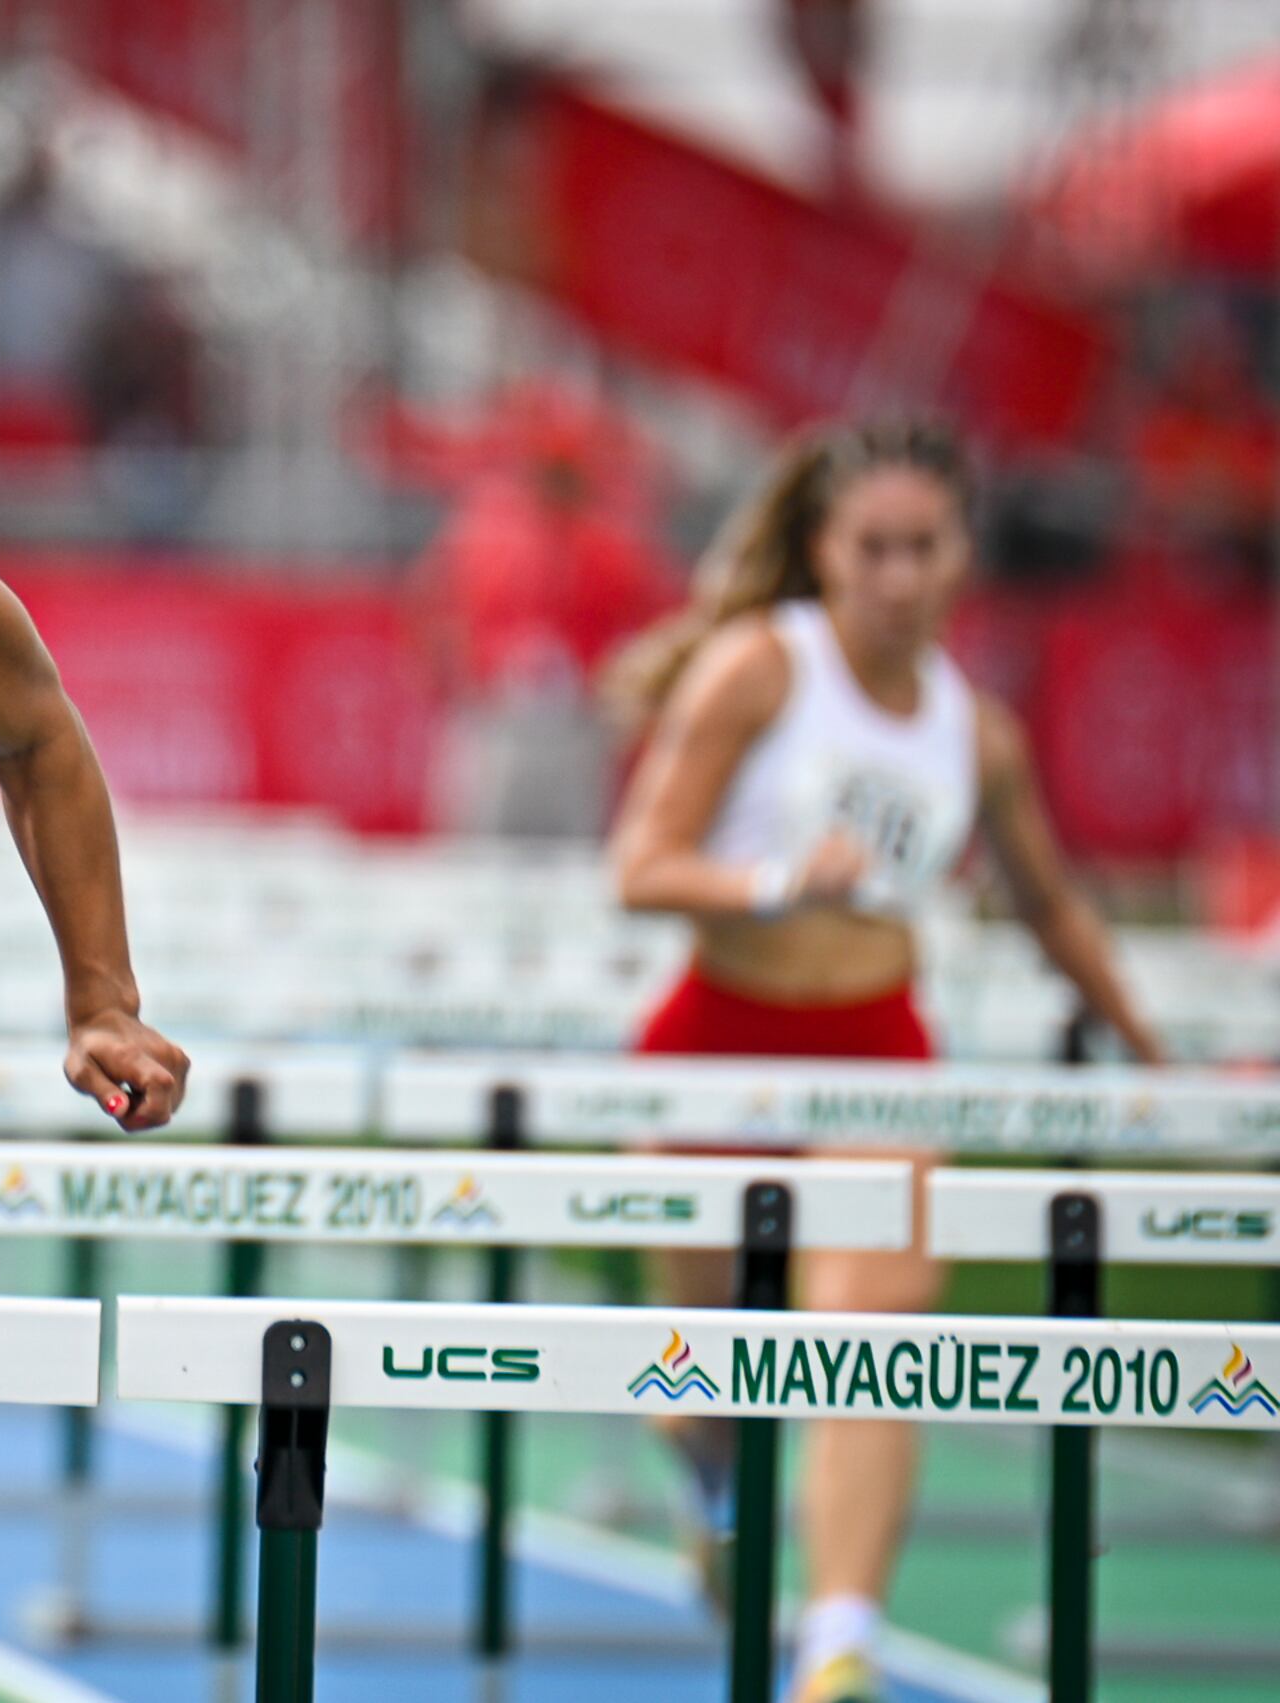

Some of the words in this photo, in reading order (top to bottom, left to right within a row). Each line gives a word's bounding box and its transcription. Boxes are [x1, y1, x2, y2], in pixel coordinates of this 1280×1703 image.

[325, 1171, 423, 1228] 2010
[567, 1192, 697, 1222] UCS
[1140, 1206, 1271, 1240] UCS
[382, 1345, 541, 1382] UCS
[731, 1334, 1040, 1413] MAYAGÜEZ
[1061, 1346, 1181, 1416] 2010
